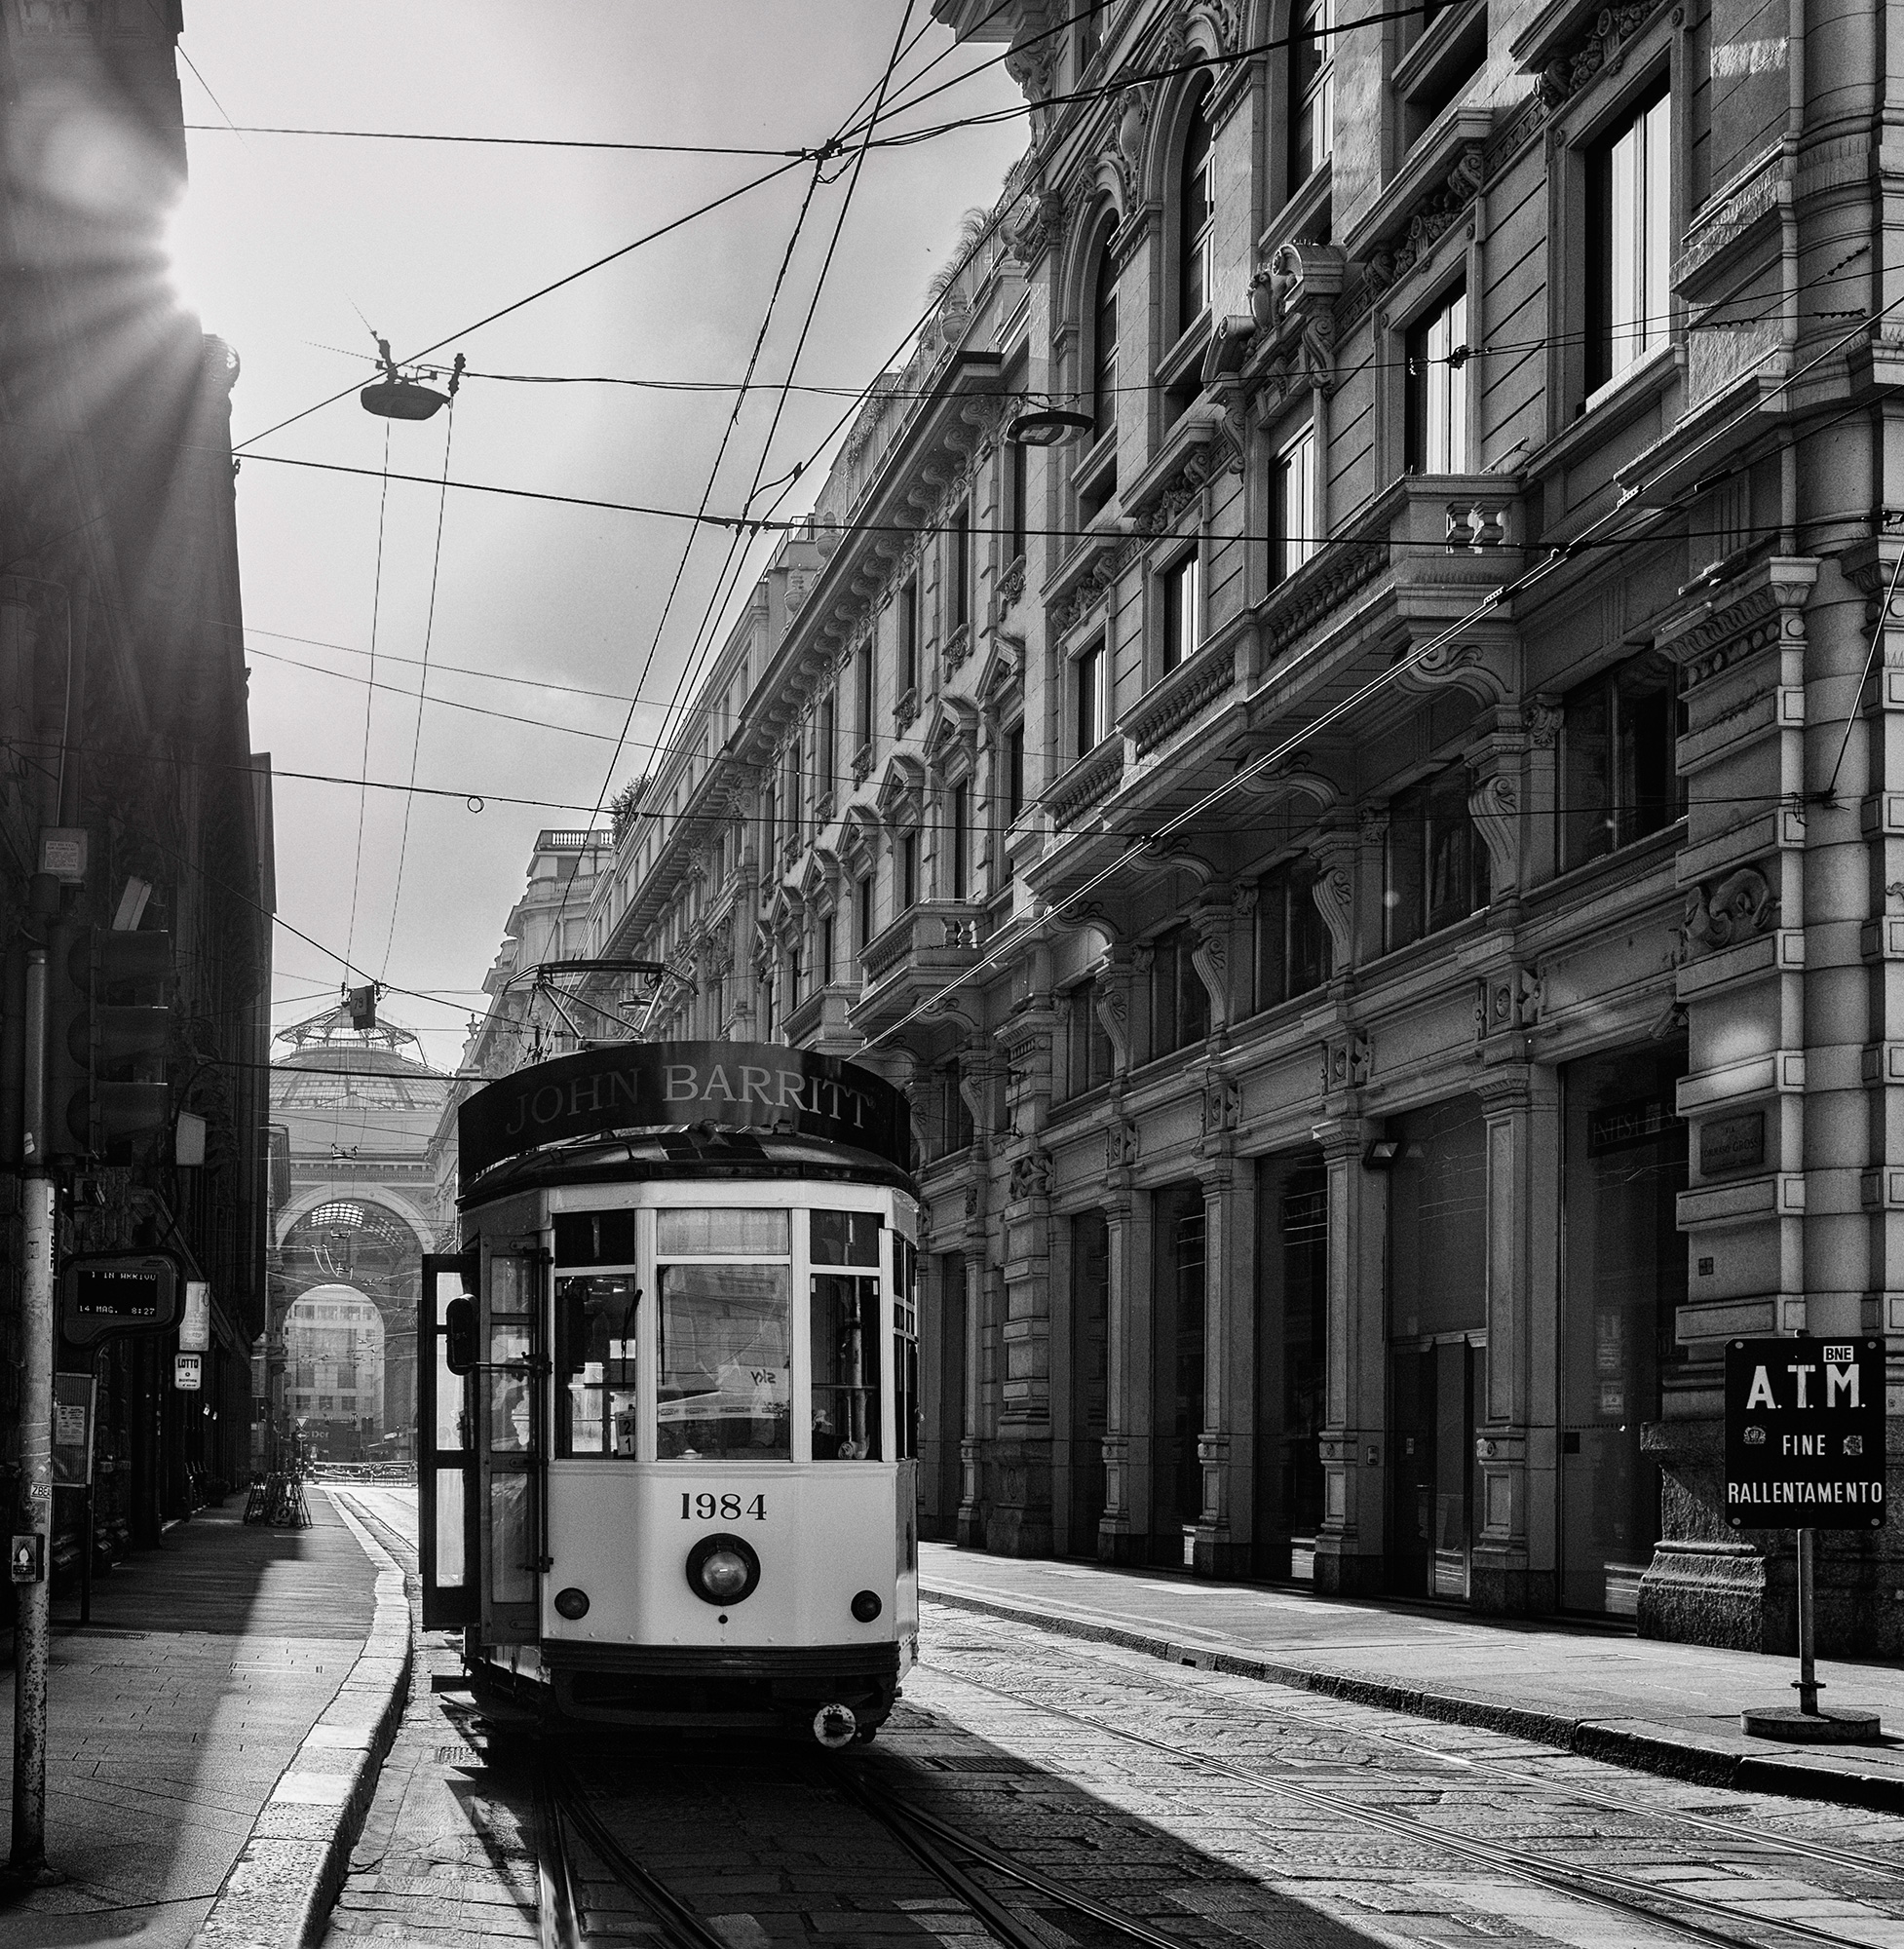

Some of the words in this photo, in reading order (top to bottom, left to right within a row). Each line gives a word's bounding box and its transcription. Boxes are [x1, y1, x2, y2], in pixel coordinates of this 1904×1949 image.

[506, 1067, 643, 1135] JOHN
[662, 1064, 871, 1128] BARRITT
[79, 1305, 92, 1314] 14
[95, 1305, 119, 1315] MAG.
[131, 1307, 156, 1316] 8:27
[1825, 1347, 1852, 1360] BNE
[177, 1358, 199, 1368] LOTTO
[624, 1420, 631, 1434] 2
[625, 1437, 631, 1452] 1
[1782, 1434, 1826, 1456] FINE
[1728, 1481, 1884, 1504] RALLENTAMENTO
[680, 1492, 768, 1521] 1984
